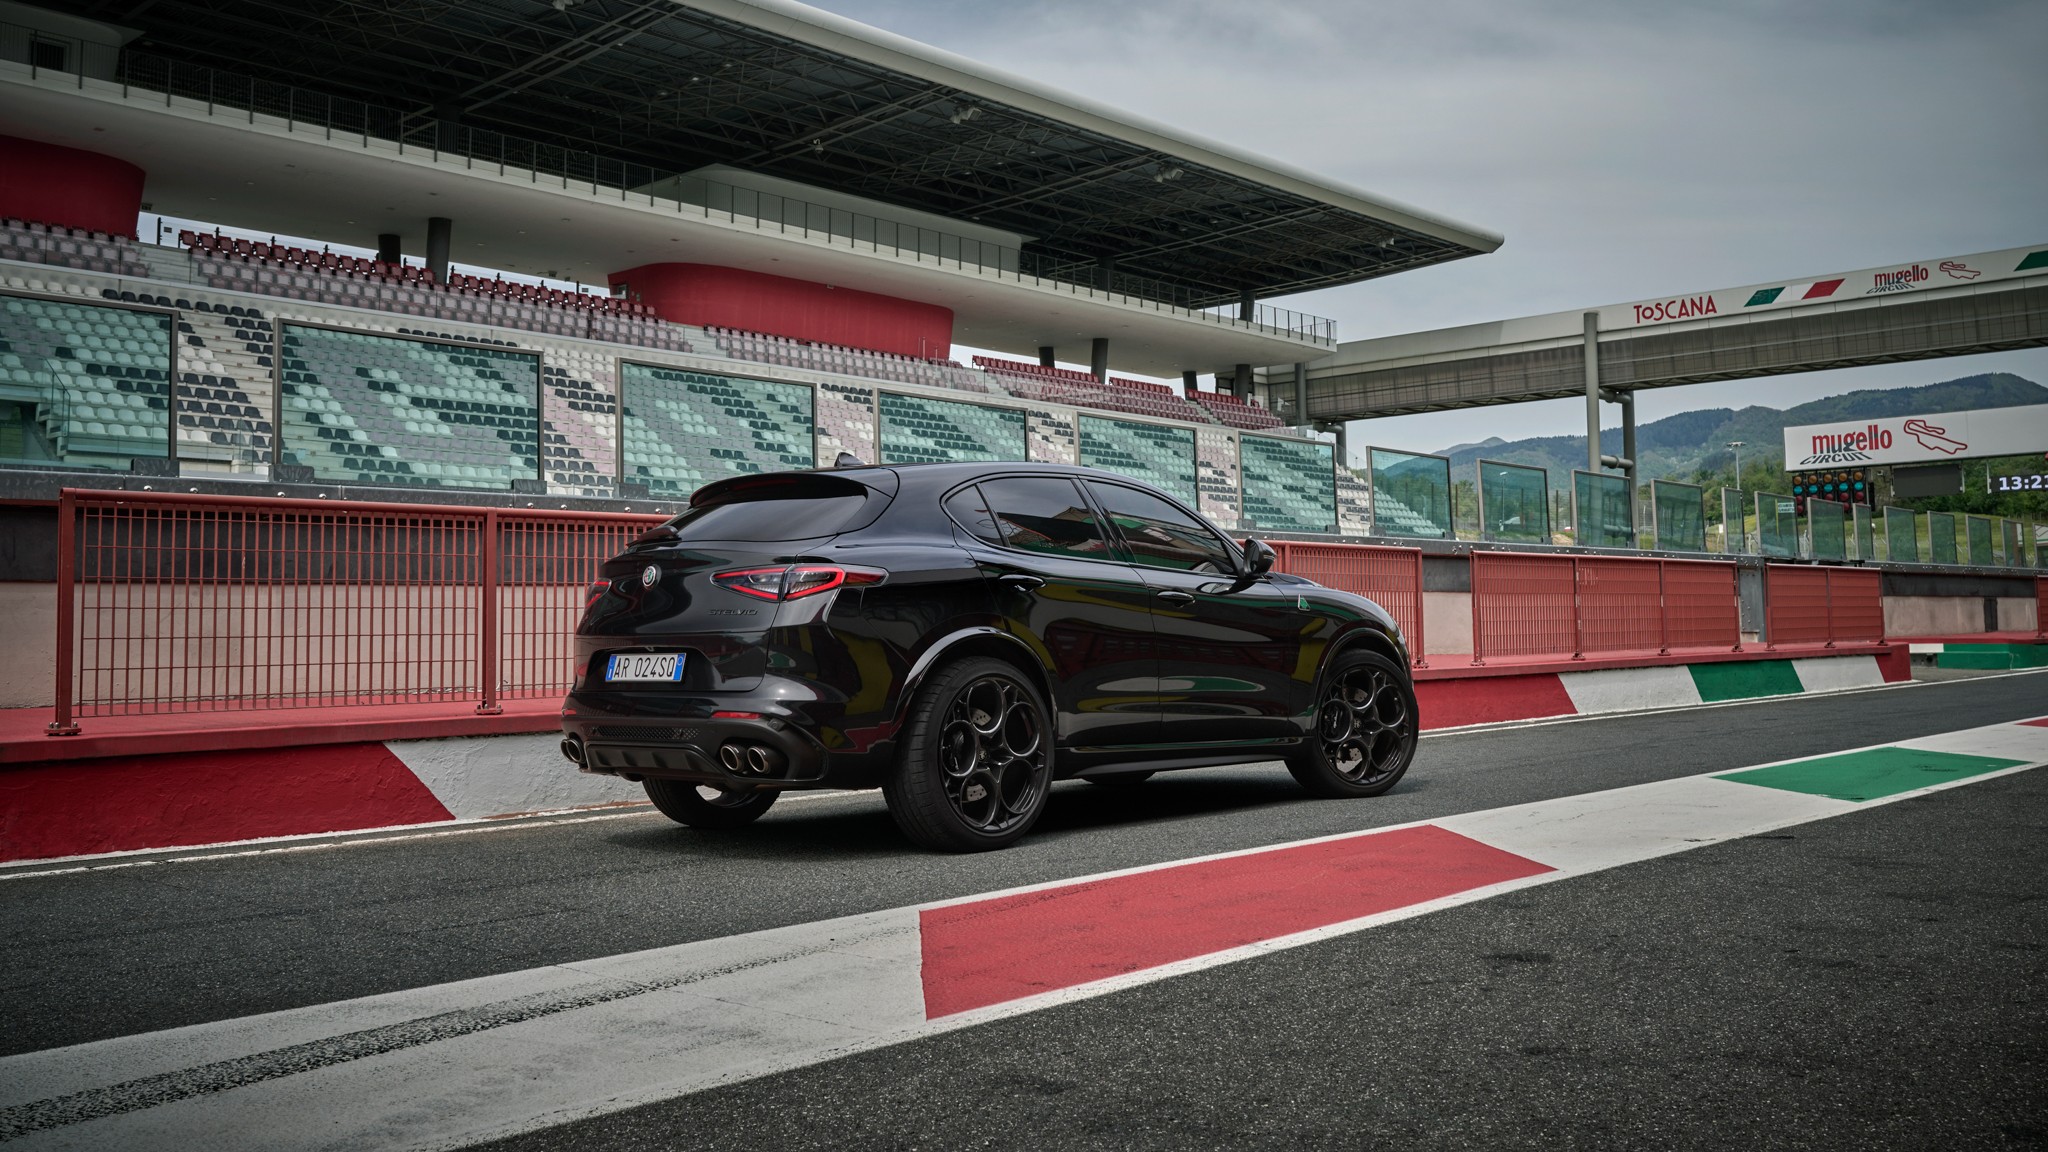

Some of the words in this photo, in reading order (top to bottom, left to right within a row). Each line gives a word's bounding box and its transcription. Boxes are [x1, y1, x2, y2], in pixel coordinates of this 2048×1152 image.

[1874, 264, 1929, 287] mugello
[1866, 283, 1915, 294] CIRCUIT
[1633, 295, 1717, 324] TOSCANA
[1812, 424, 1892, 455] mugello
[1800, 451, 1873, 465] CIRCUIT
[613, 657, 630, 678] AR
[634, 656, 676, 678] 024SQ
